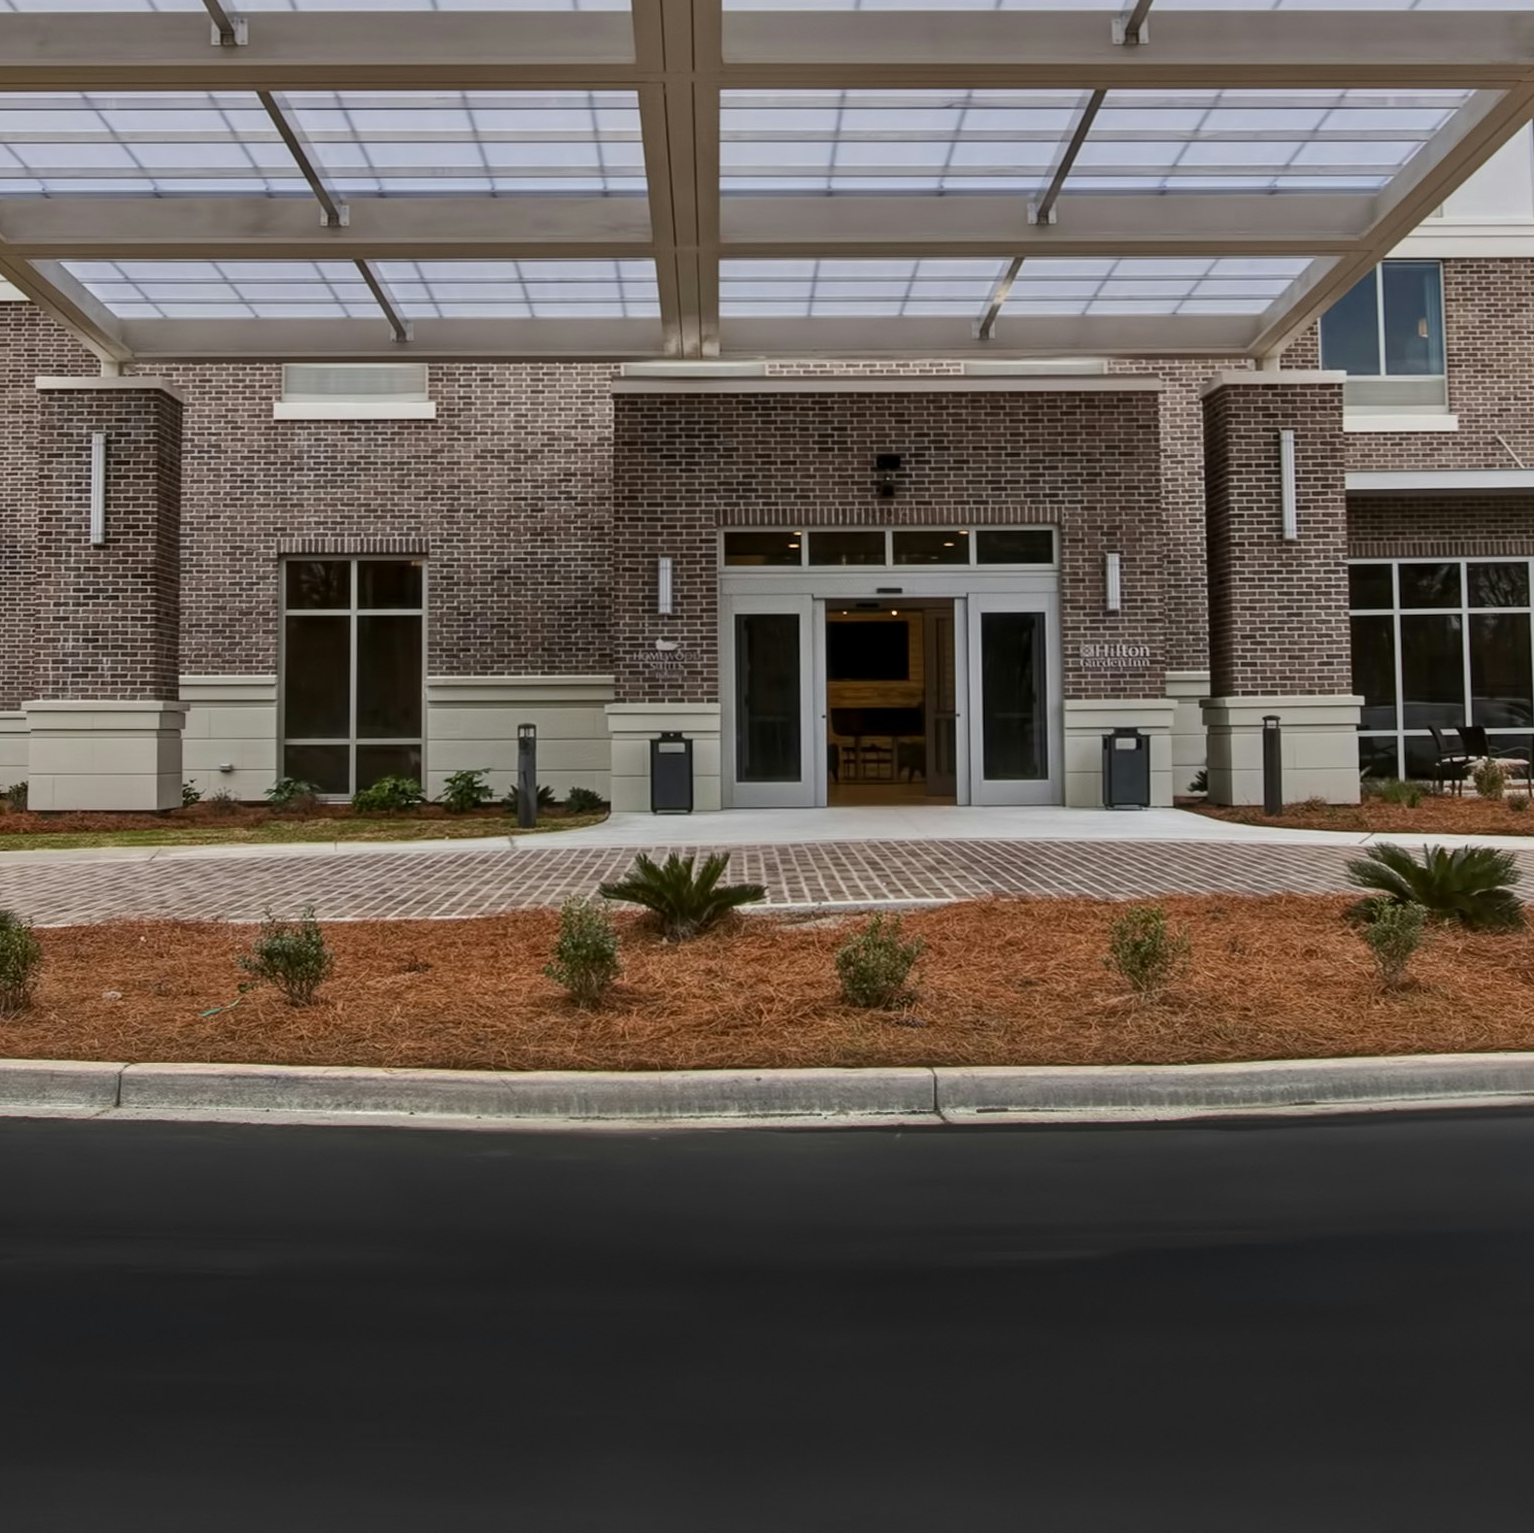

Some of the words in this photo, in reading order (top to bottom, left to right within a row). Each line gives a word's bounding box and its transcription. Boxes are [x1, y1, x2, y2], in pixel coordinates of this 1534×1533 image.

[1095, 643, 1150, 657] Hilton
[1080, 657, 1127, 667] Garden
[1128, 657, 1151, 667] Inn
